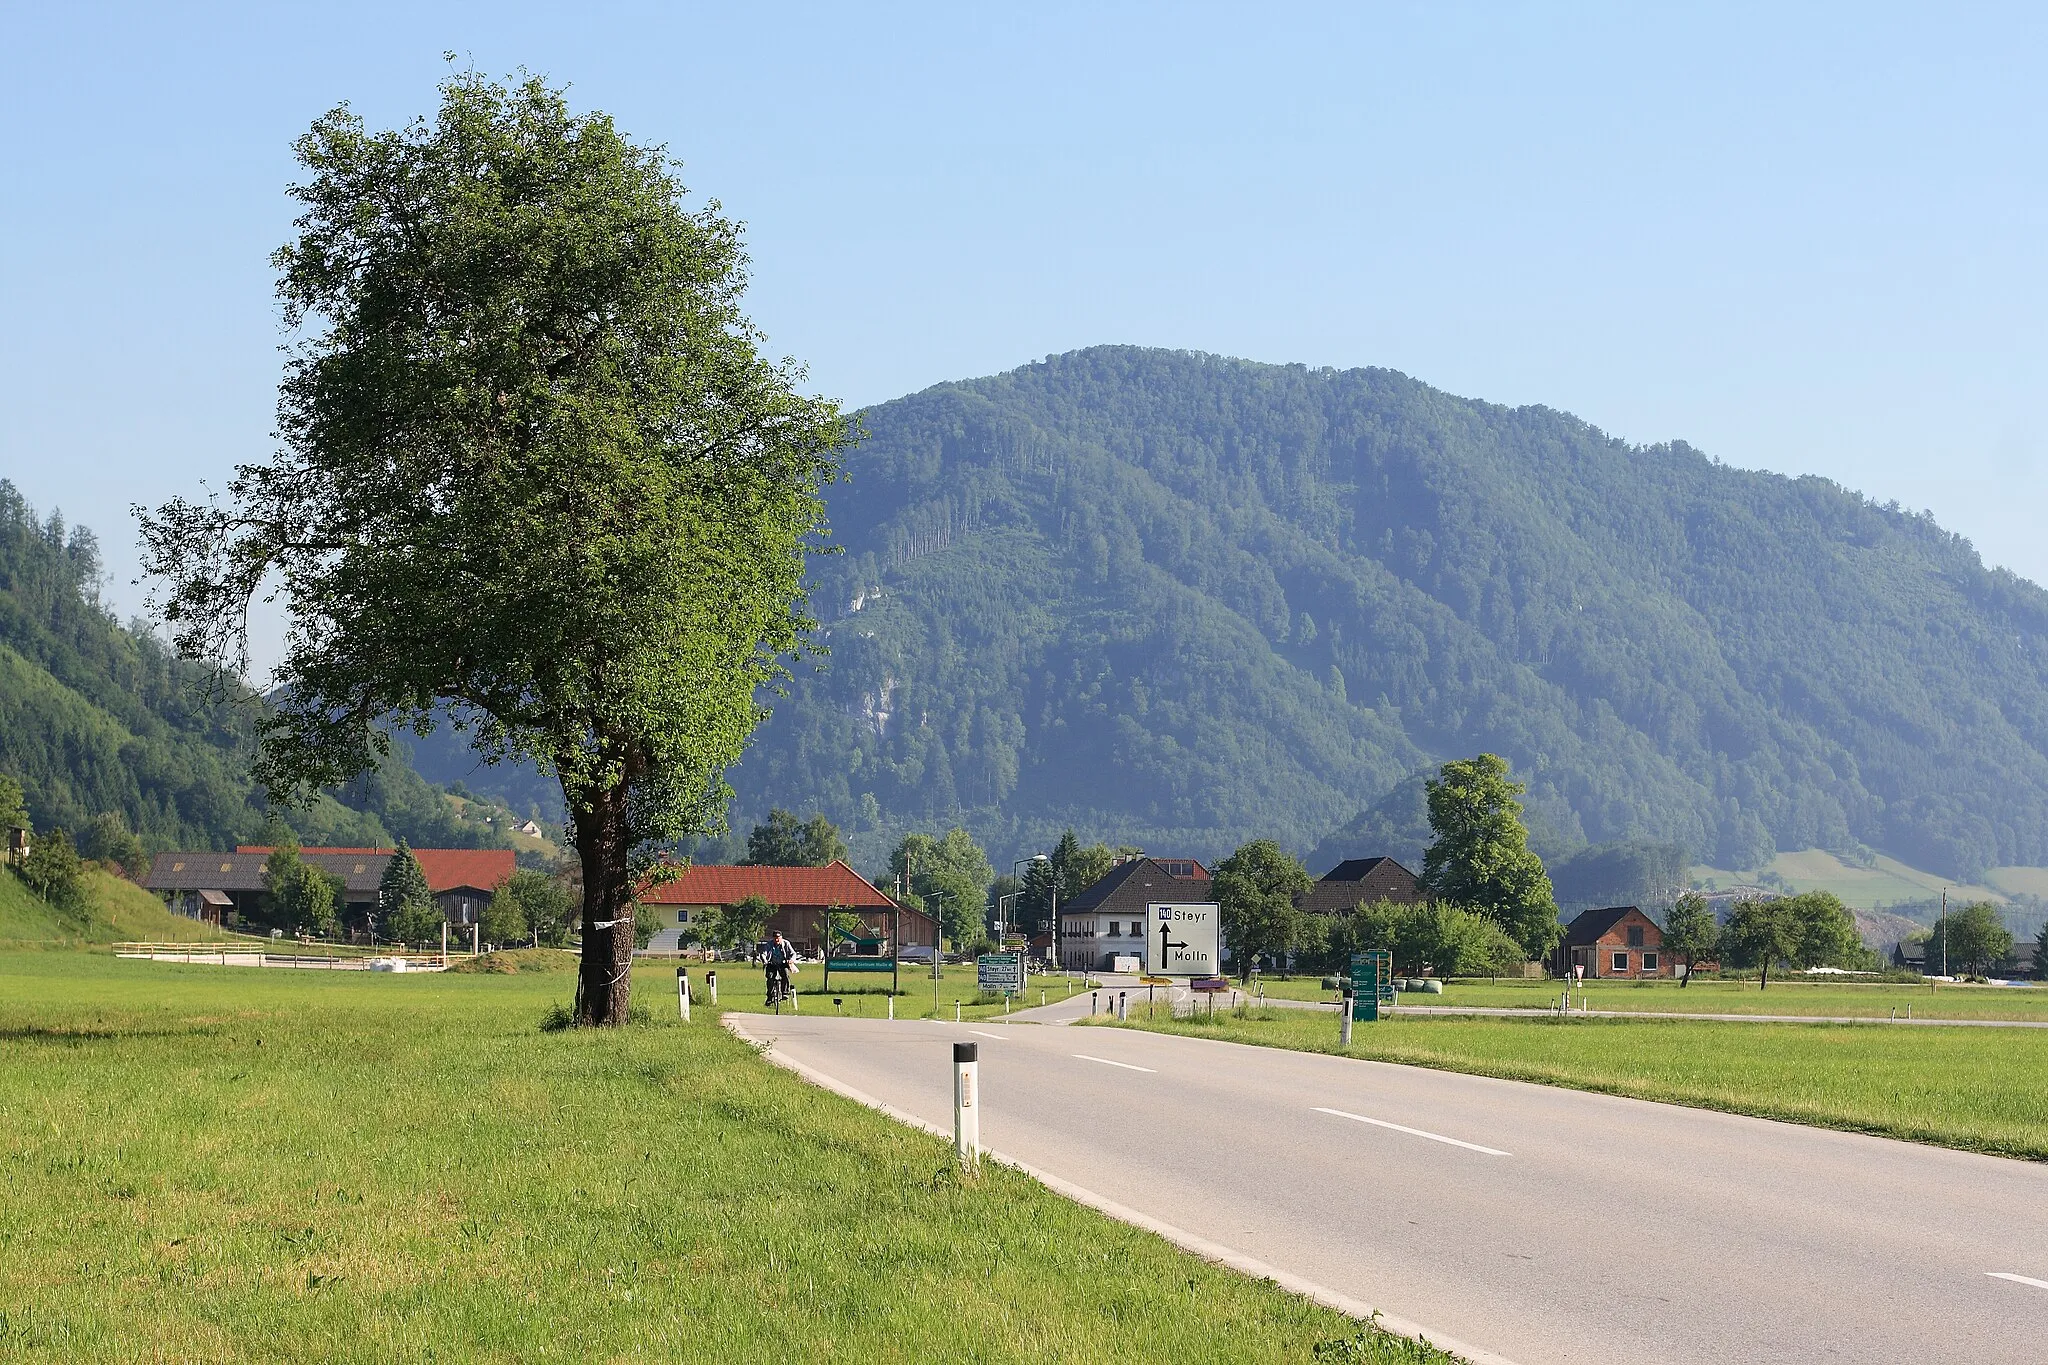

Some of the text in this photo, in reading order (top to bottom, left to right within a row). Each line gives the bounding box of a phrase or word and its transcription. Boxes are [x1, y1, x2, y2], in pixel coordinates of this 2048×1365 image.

[1160, 909, 1207, 923] 140 Steyr
[1175, 951, 1208, 960] Molln
